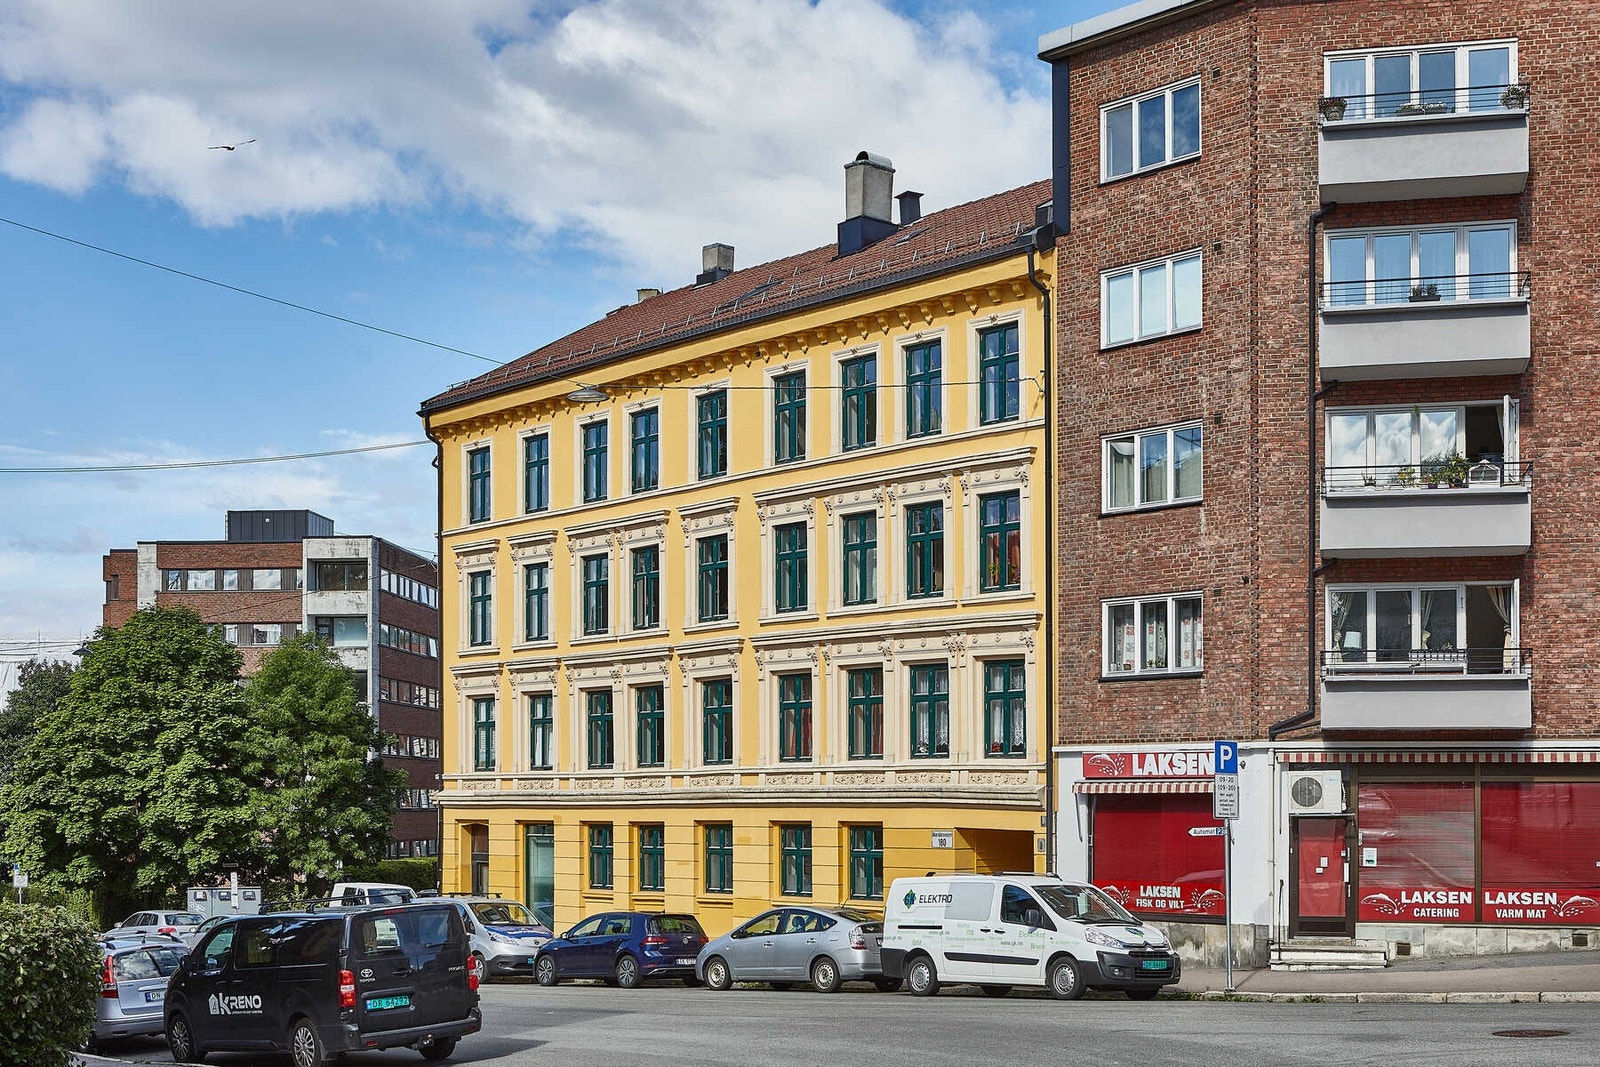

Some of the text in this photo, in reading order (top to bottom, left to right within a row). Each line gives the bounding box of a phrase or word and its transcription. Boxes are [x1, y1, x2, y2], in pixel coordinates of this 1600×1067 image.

[1219, 745, 1233, 770] P
[1132, 753, 1215, 775] LAKSEN
[938, 838, 947, 847] 180
[1139, 885, 1181, 899] LAKSEN
[1401, 891, 1473, 905] LAKSEN
[1484, 891, 1557, 905] LAKSEN
[918, 894, 953, 904] ELEKTRO
[1136, 899, 1185, 909] FISK OG VILT
[1413, 907, 1460, 918] CATERING
[1495, 908, 1547, 919] VARM MAT
